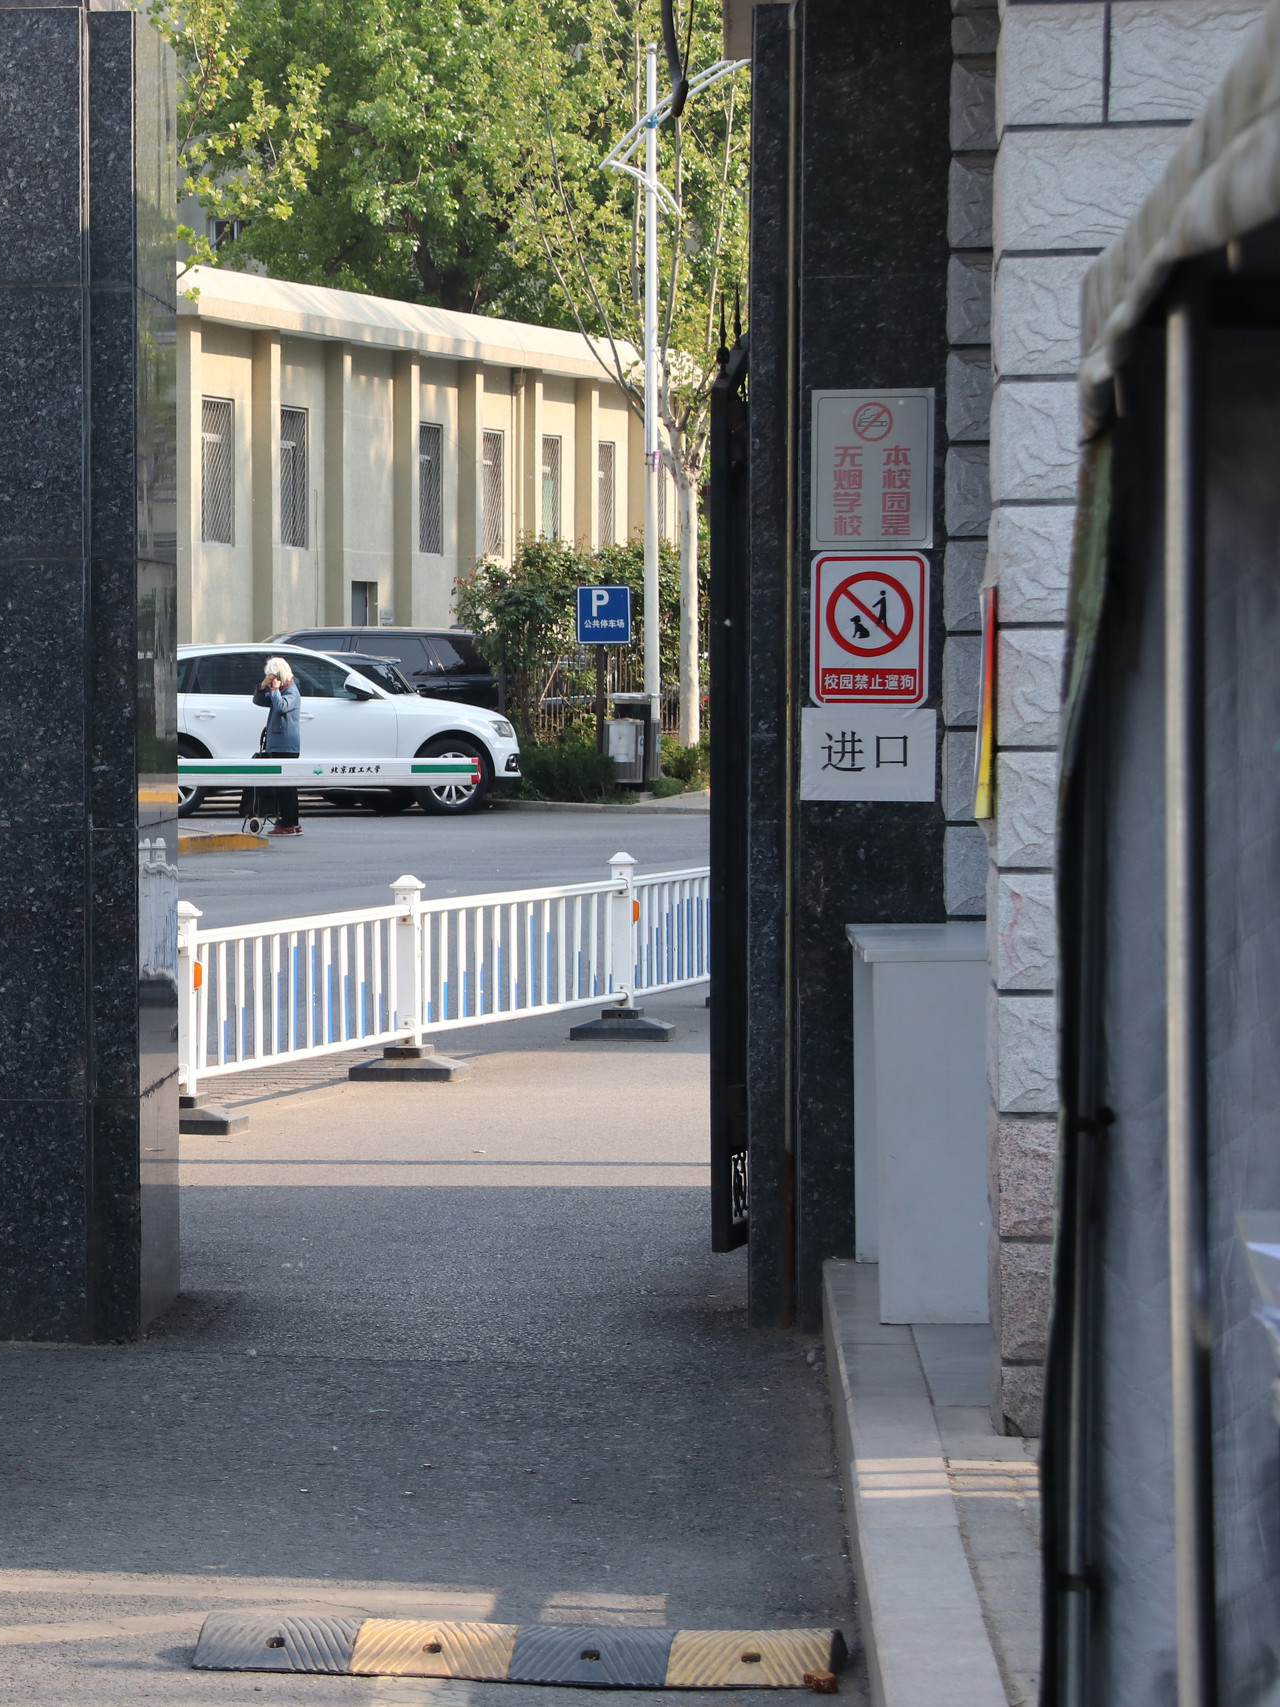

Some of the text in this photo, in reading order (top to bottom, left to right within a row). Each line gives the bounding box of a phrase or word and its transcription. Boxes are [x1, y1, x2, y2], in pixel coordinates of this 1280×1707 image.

[833, 445, 863, 537] 无烟学校
[881, 445, 912, 536] 本校园是
[591, 589, 610, 617] P
[583, 619, 625, 629] 公共停车场
[824, 673, 914, 690] 校园禁止遛狗
[820, 730, 909, 772] 进口
